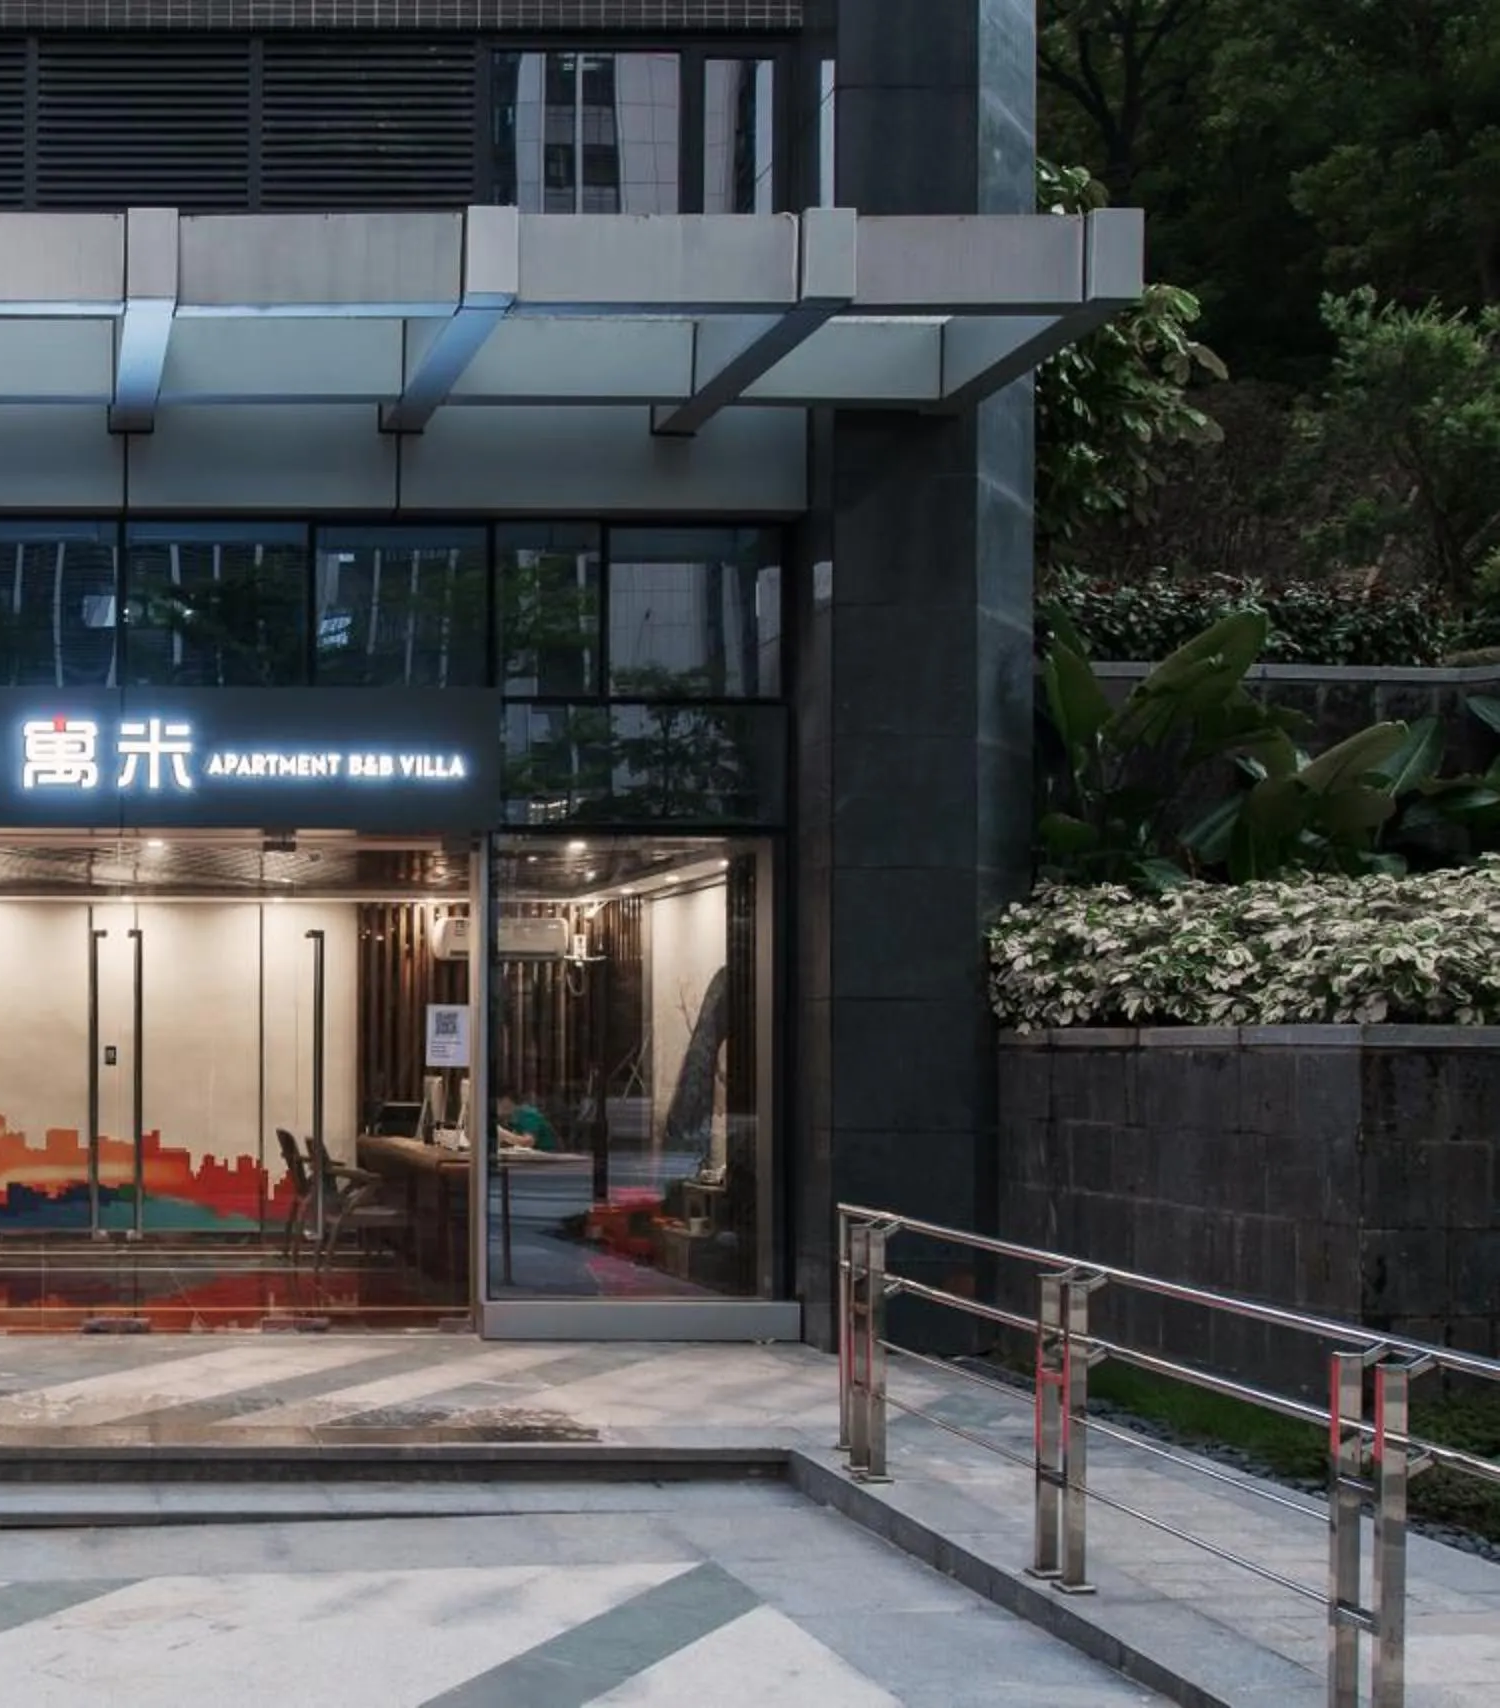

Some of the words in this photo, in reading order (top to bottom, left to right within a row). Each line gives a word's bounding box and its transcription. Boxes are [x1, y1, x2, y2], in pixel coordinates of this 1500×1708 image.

[207, 753, 342, 777] APARTMENT
[348, 754, 395, 777] B&B
[399, 754, 465, 777] VILLA
